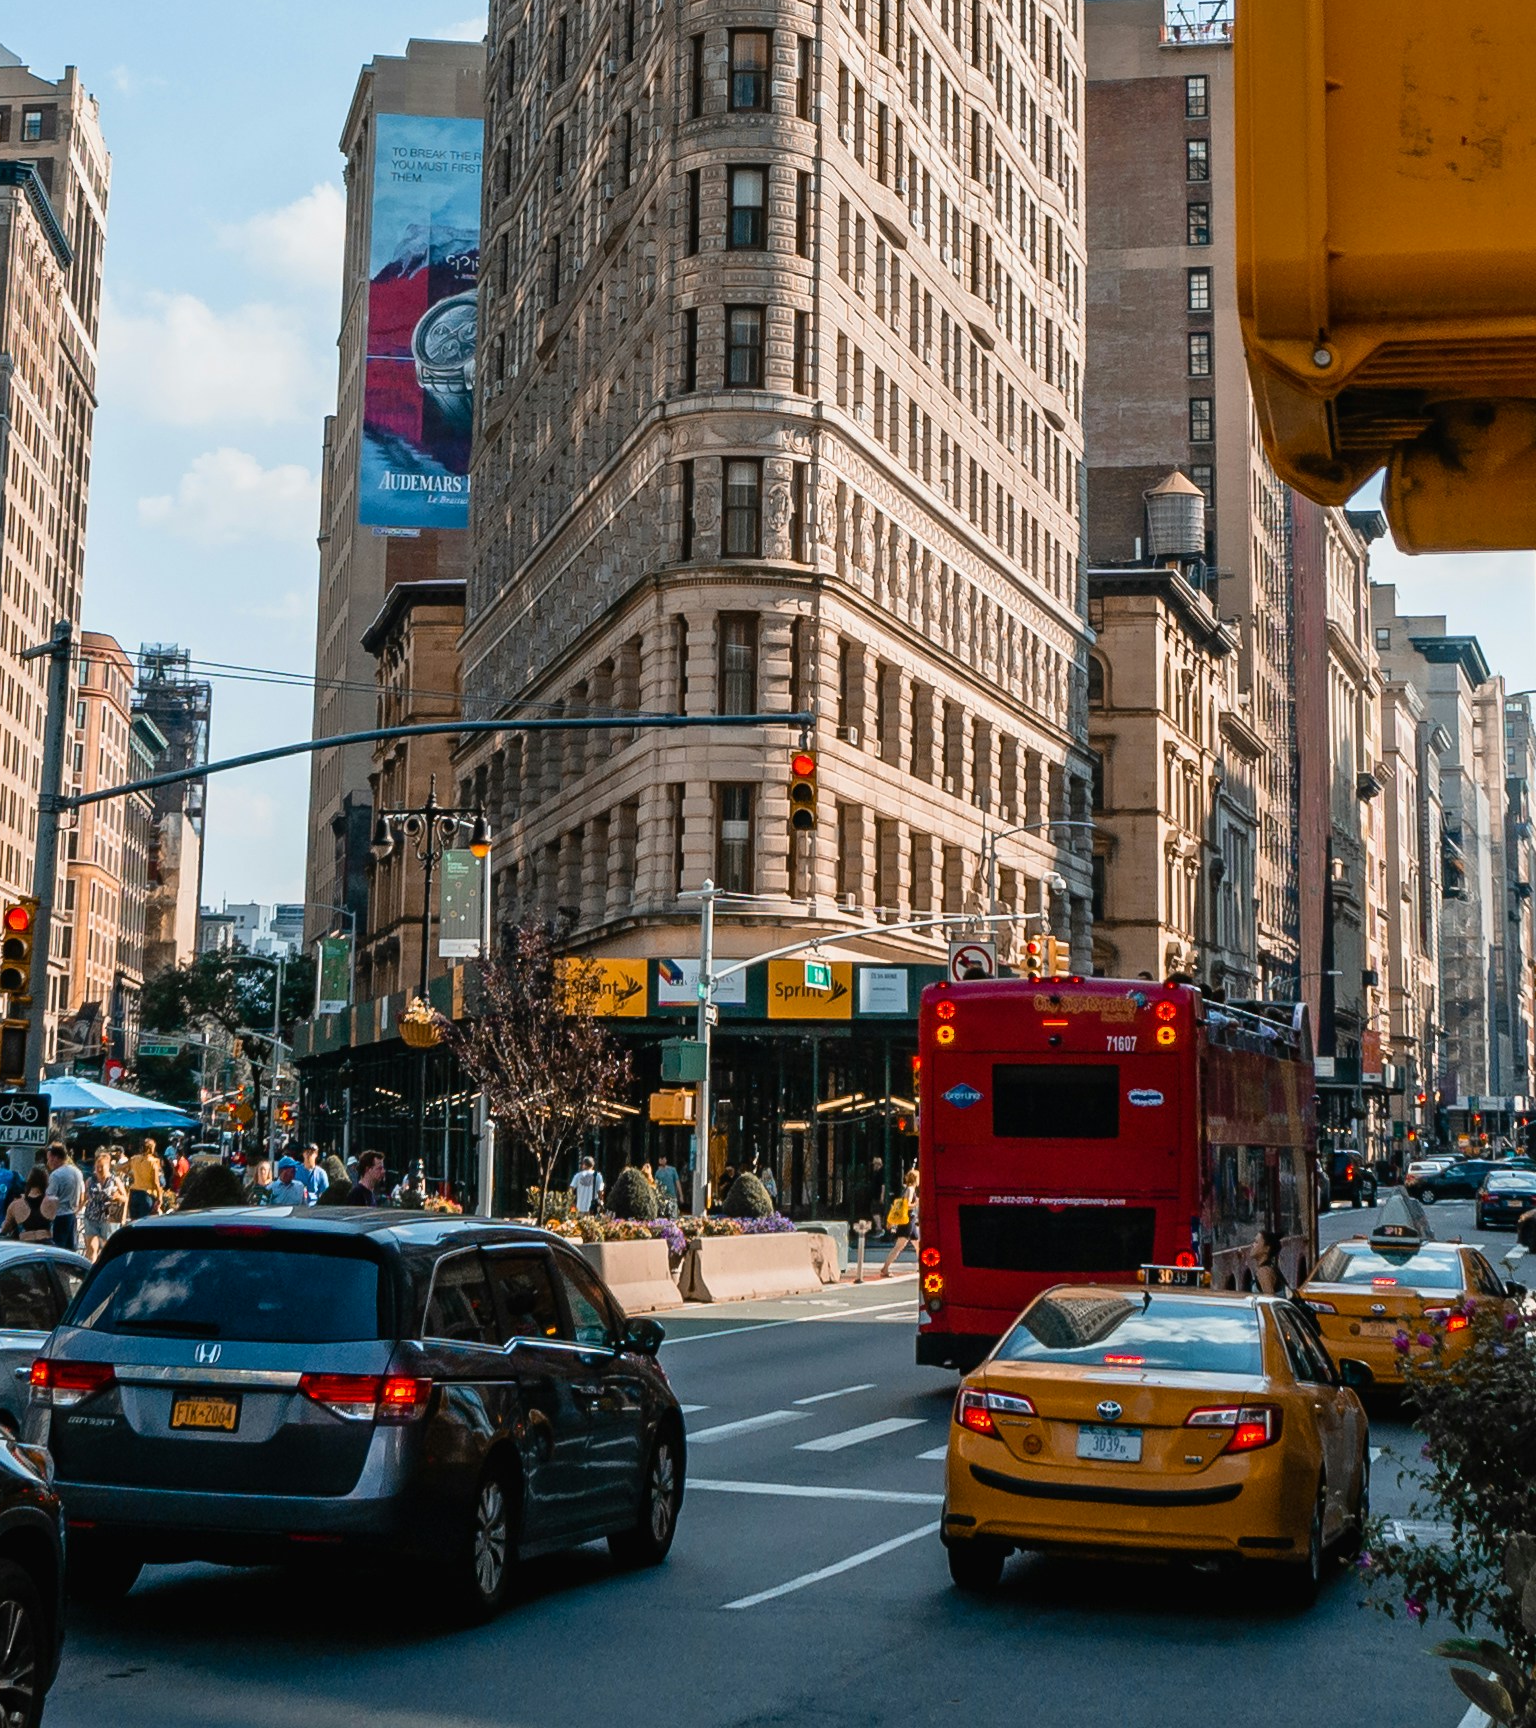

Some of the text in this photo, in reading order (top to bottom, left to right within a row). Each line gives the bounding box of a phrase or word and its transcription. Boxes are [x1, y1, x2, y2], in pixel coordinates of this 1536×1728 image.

[392, 147, 408, 157] TO
[410, 148, 446, 159] BREAK
[449, 151, 471, 161] THE
[392, 160, 482, 174] YOU MUST FIRST
[378, 471, 462, 493] AUDEMARS
[1107, 1035, 1137, 1052] 71607
[15, 1128, 45, 1142] LANE
[1157, 1268, 1189, 1284] 3D39
